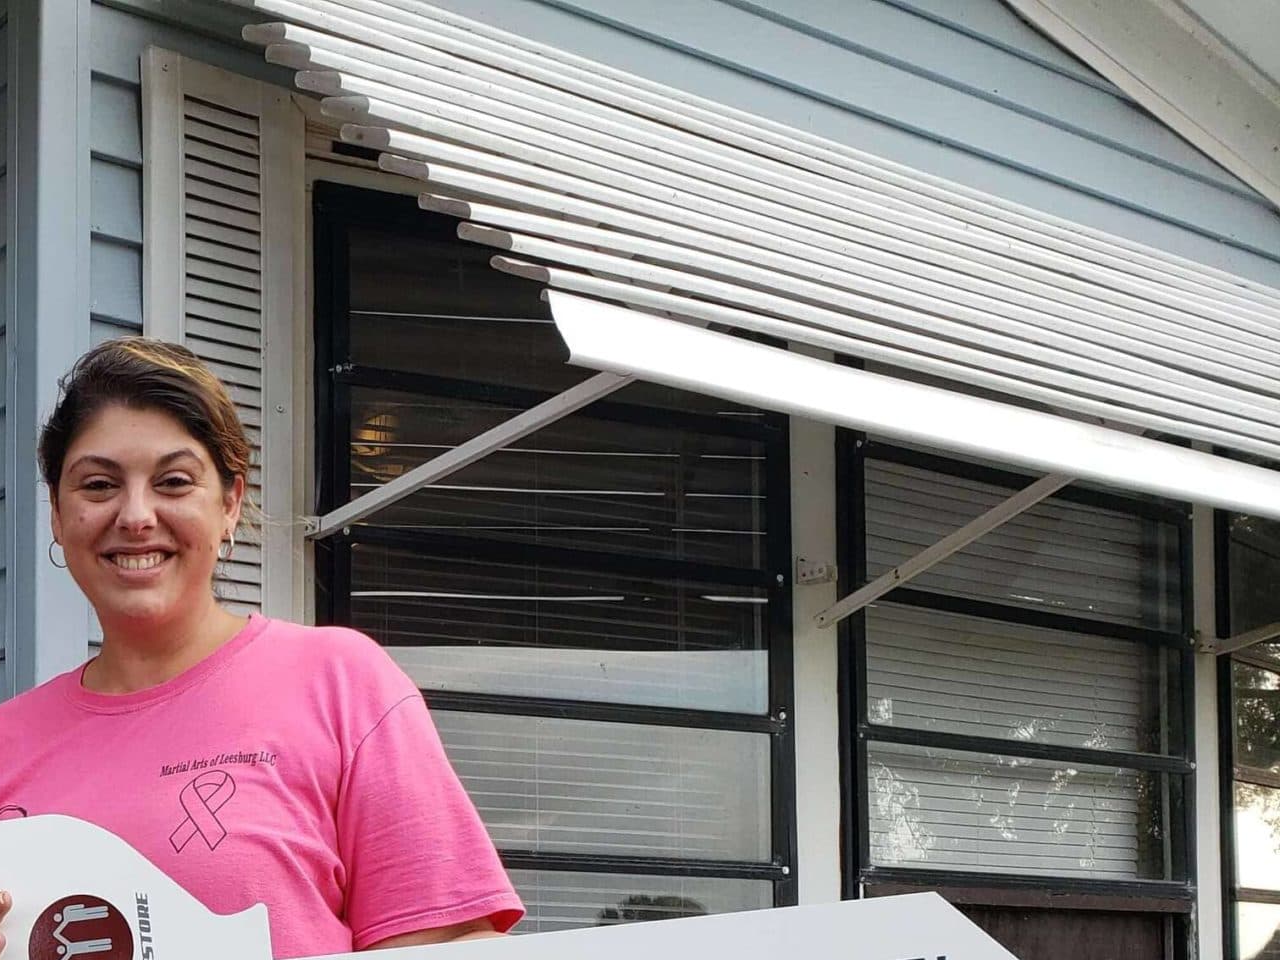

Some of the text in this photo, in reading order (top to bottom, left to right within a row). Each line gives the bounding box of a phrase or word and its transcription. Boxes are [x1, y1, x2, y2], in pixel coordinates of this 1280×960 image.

[159, 751, 277, 777] Martial Arts of Leesburg LLC
